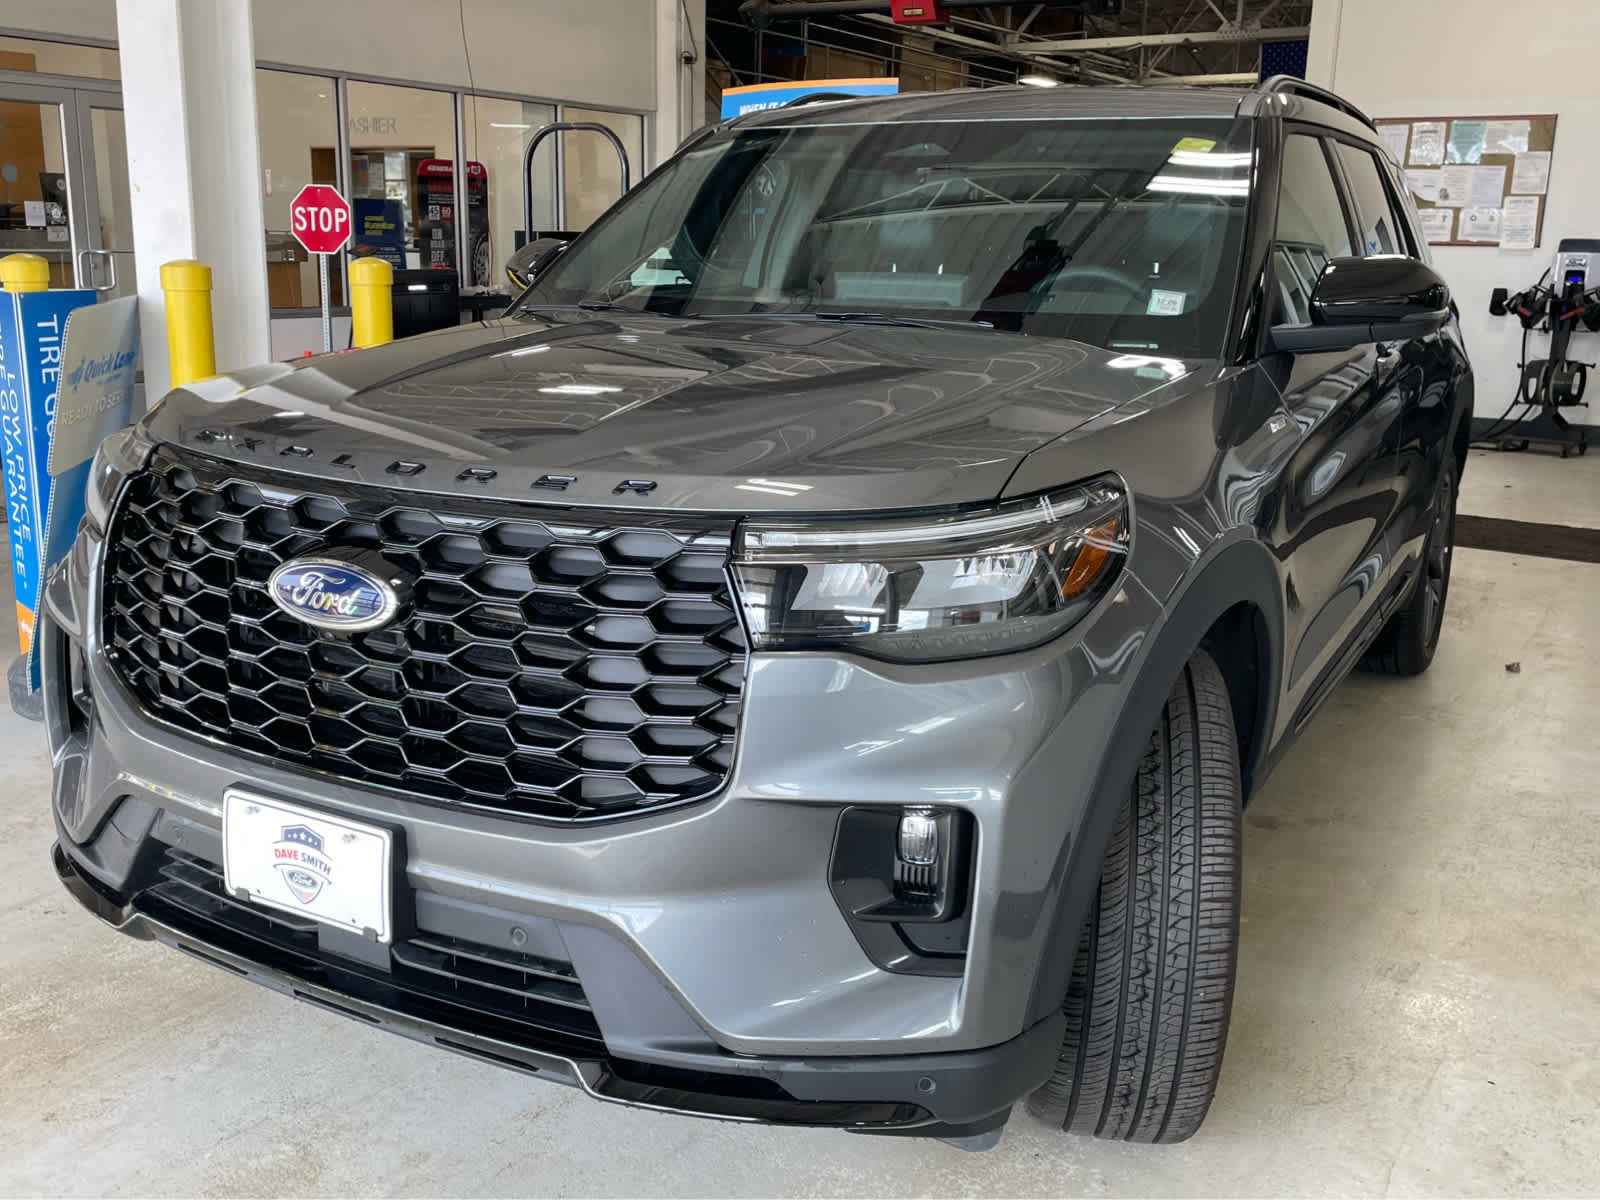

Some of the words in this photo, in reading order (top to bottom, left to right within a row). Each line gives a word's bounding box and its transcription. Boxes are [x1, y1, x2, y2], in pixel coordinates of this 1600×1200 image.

[349, 116, 398, 133] ASHIER
[295, 206, 347, 232] STOP
[37, 314, 60, 384] TIRE
[7, 373, 21, 446] LOW
[15, 454, 32, 542] PRICE
[195, 428, 659, 497] EXPLORER
[291, 571, 362, 615] Ford
[274, 848, 299, 860] DAVE
[301, 852, 331, 875] SMITH
